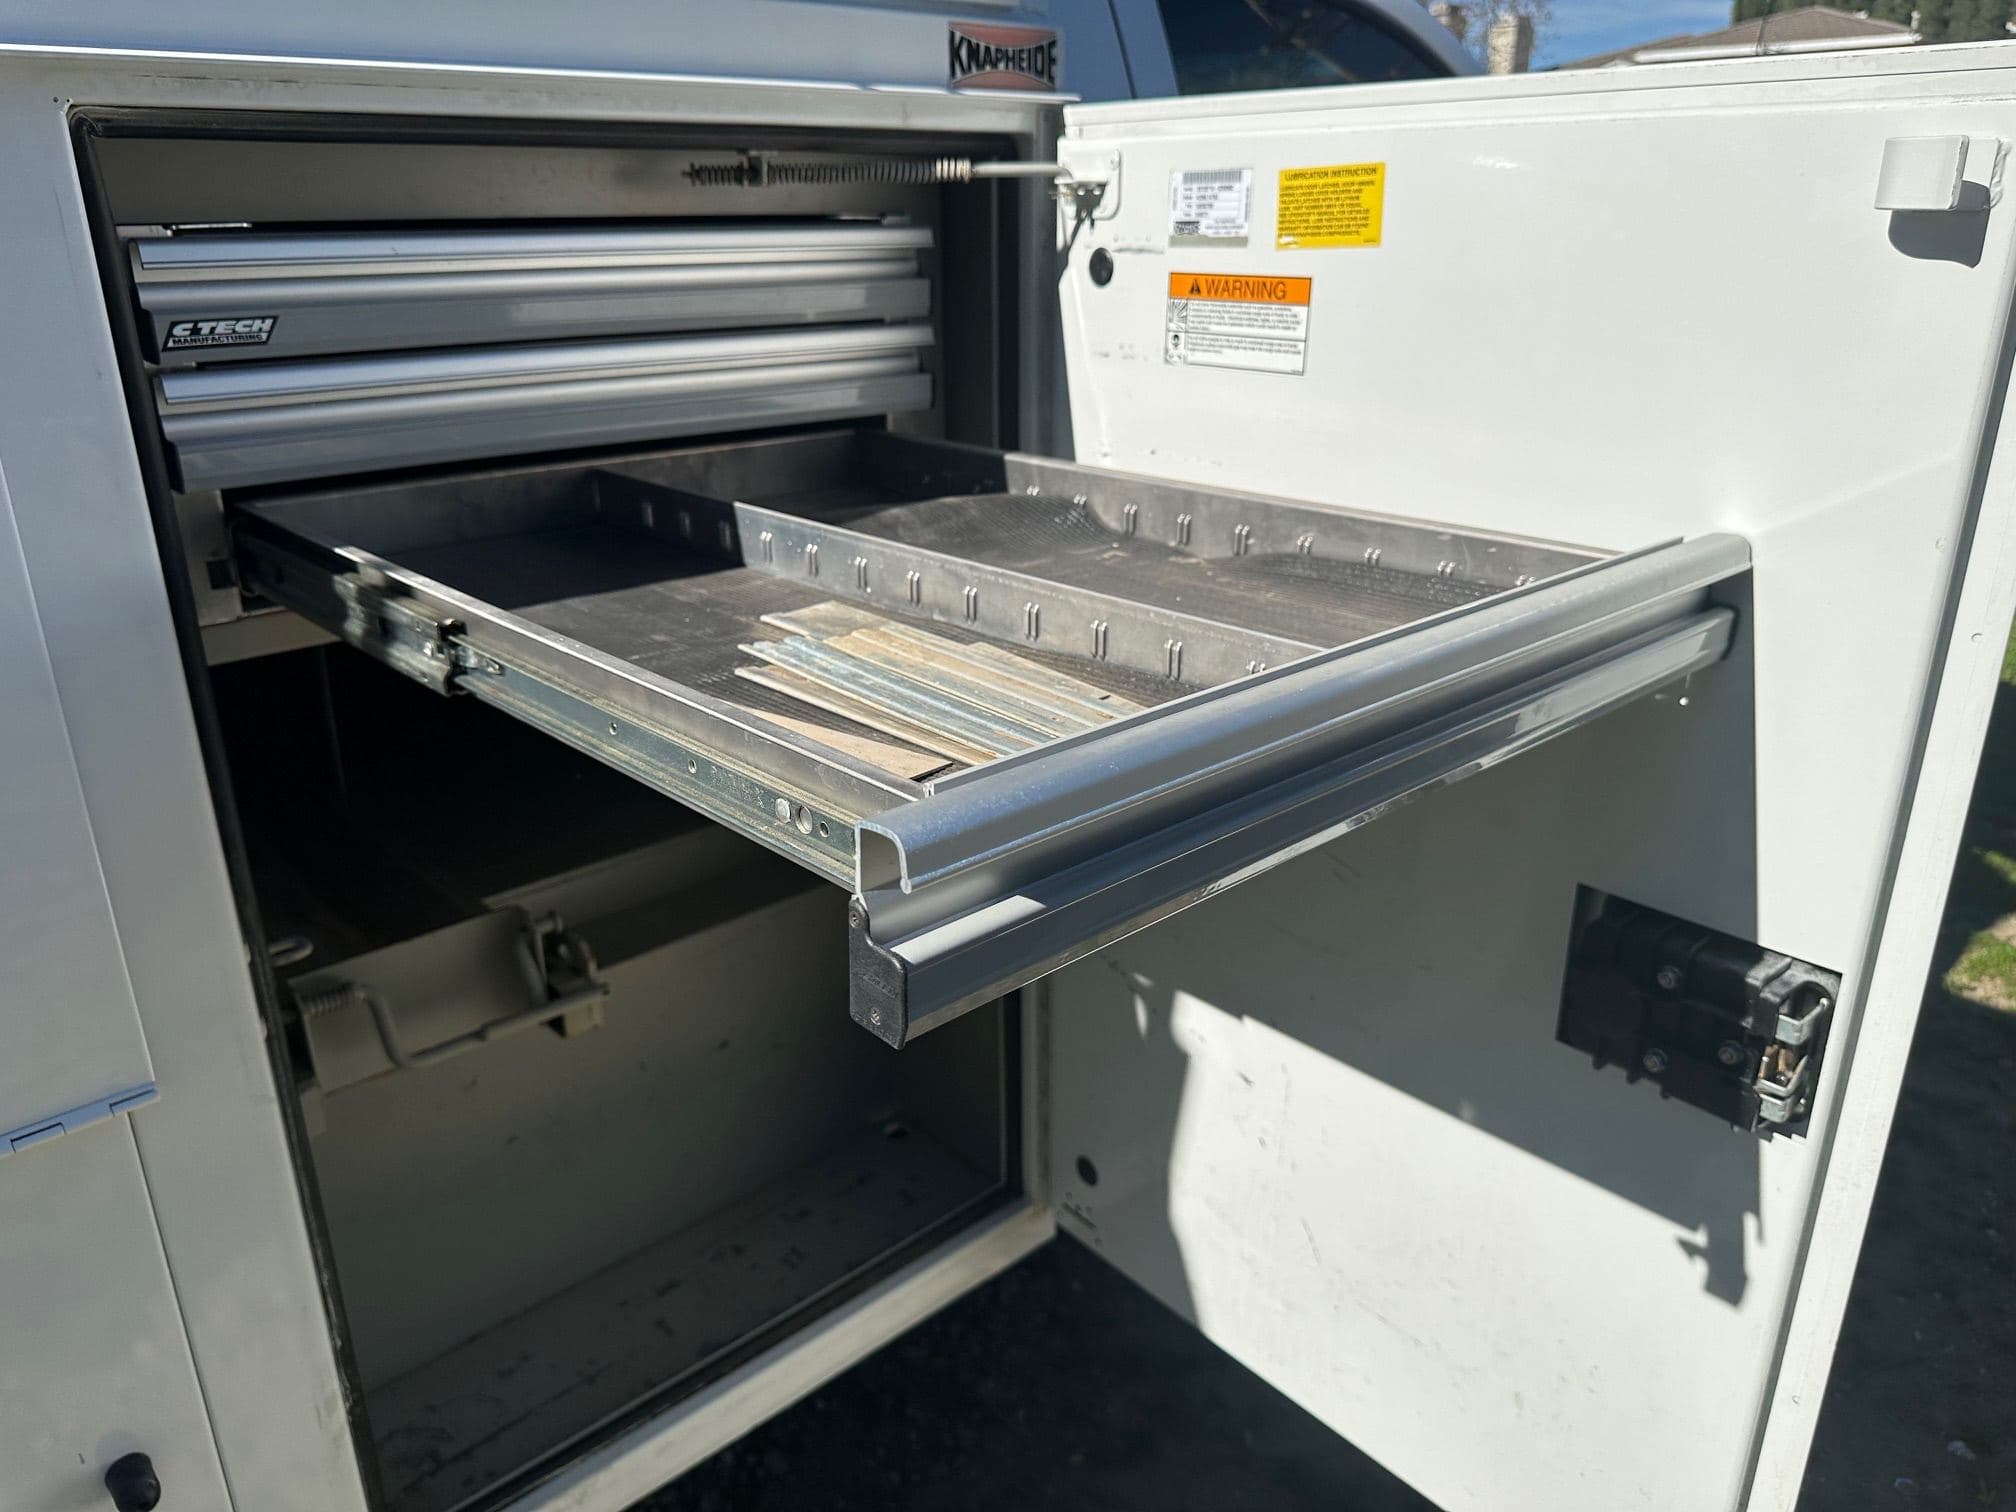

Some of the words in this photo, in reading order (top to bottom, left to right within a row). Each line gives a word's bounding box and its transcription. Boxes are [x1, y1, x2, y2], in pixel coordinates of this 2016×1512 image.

[949, 30, 1057, 86] KNAPHEIDE
[1329, 167, 1378, 178] INSTRUCTION
[1205, 277, 1287, 300] WARNING
[172, 334, 263, 346] MANUFACTURING
